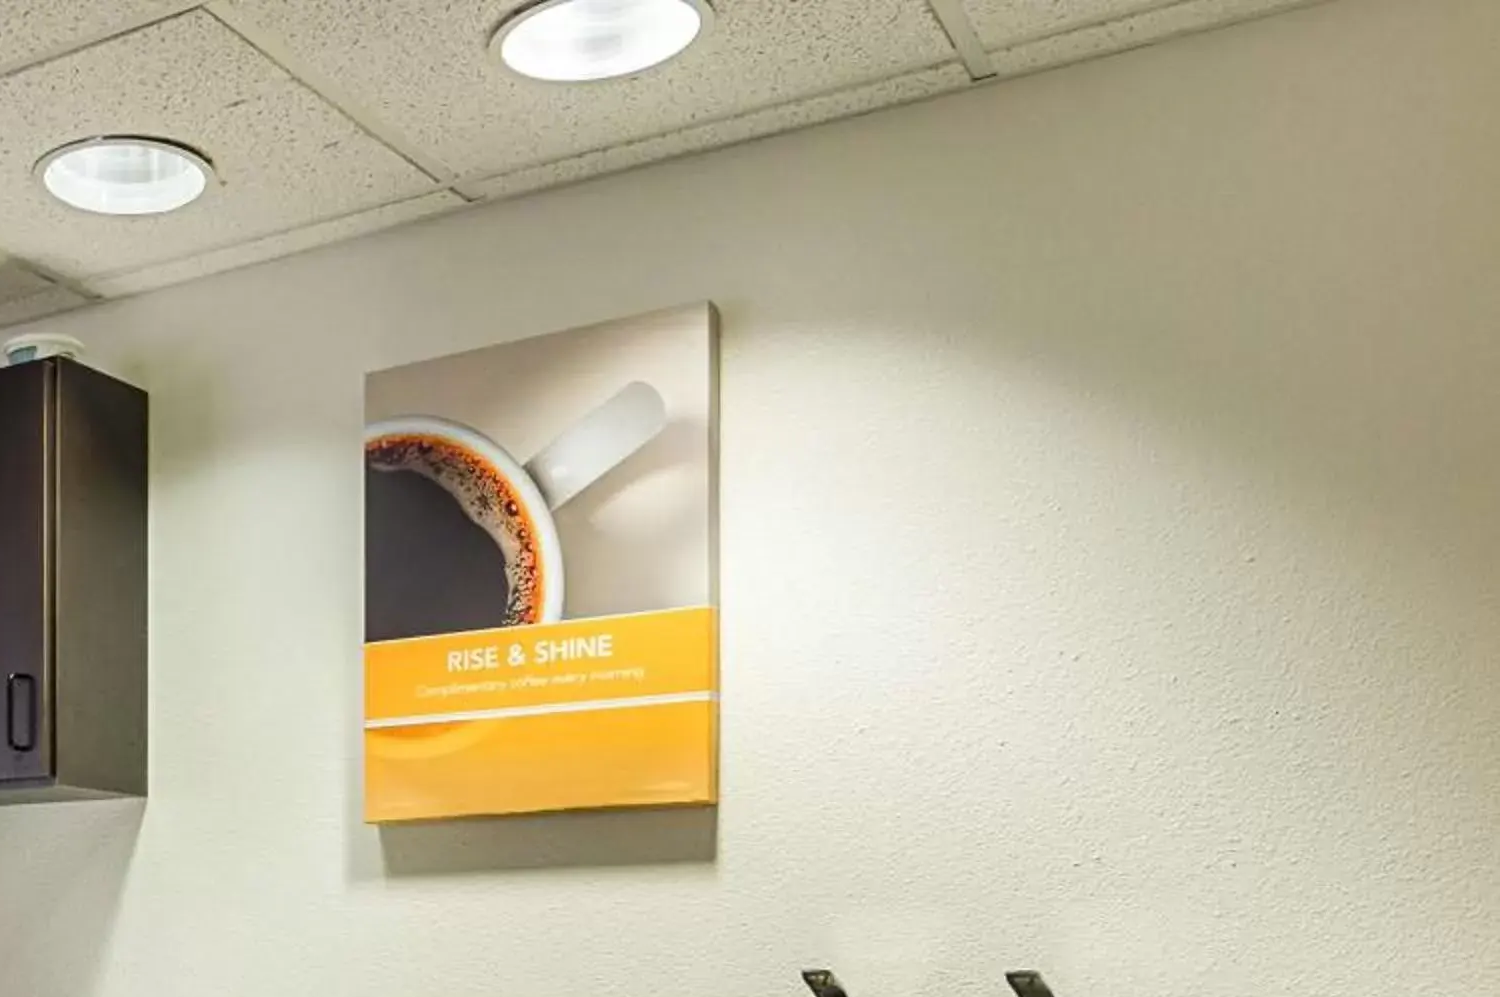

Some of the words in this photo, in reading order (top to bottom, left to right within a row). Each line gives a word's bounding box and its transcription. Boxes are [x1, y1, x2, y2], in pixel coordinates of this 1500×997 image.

[447, 645, 500, 672] RISE
[507, 643, 526, 667] &
[534, 634, 613, 664] SHINE
[551, 672, 587, 687] every
[589, 666, 645, 682] morning
